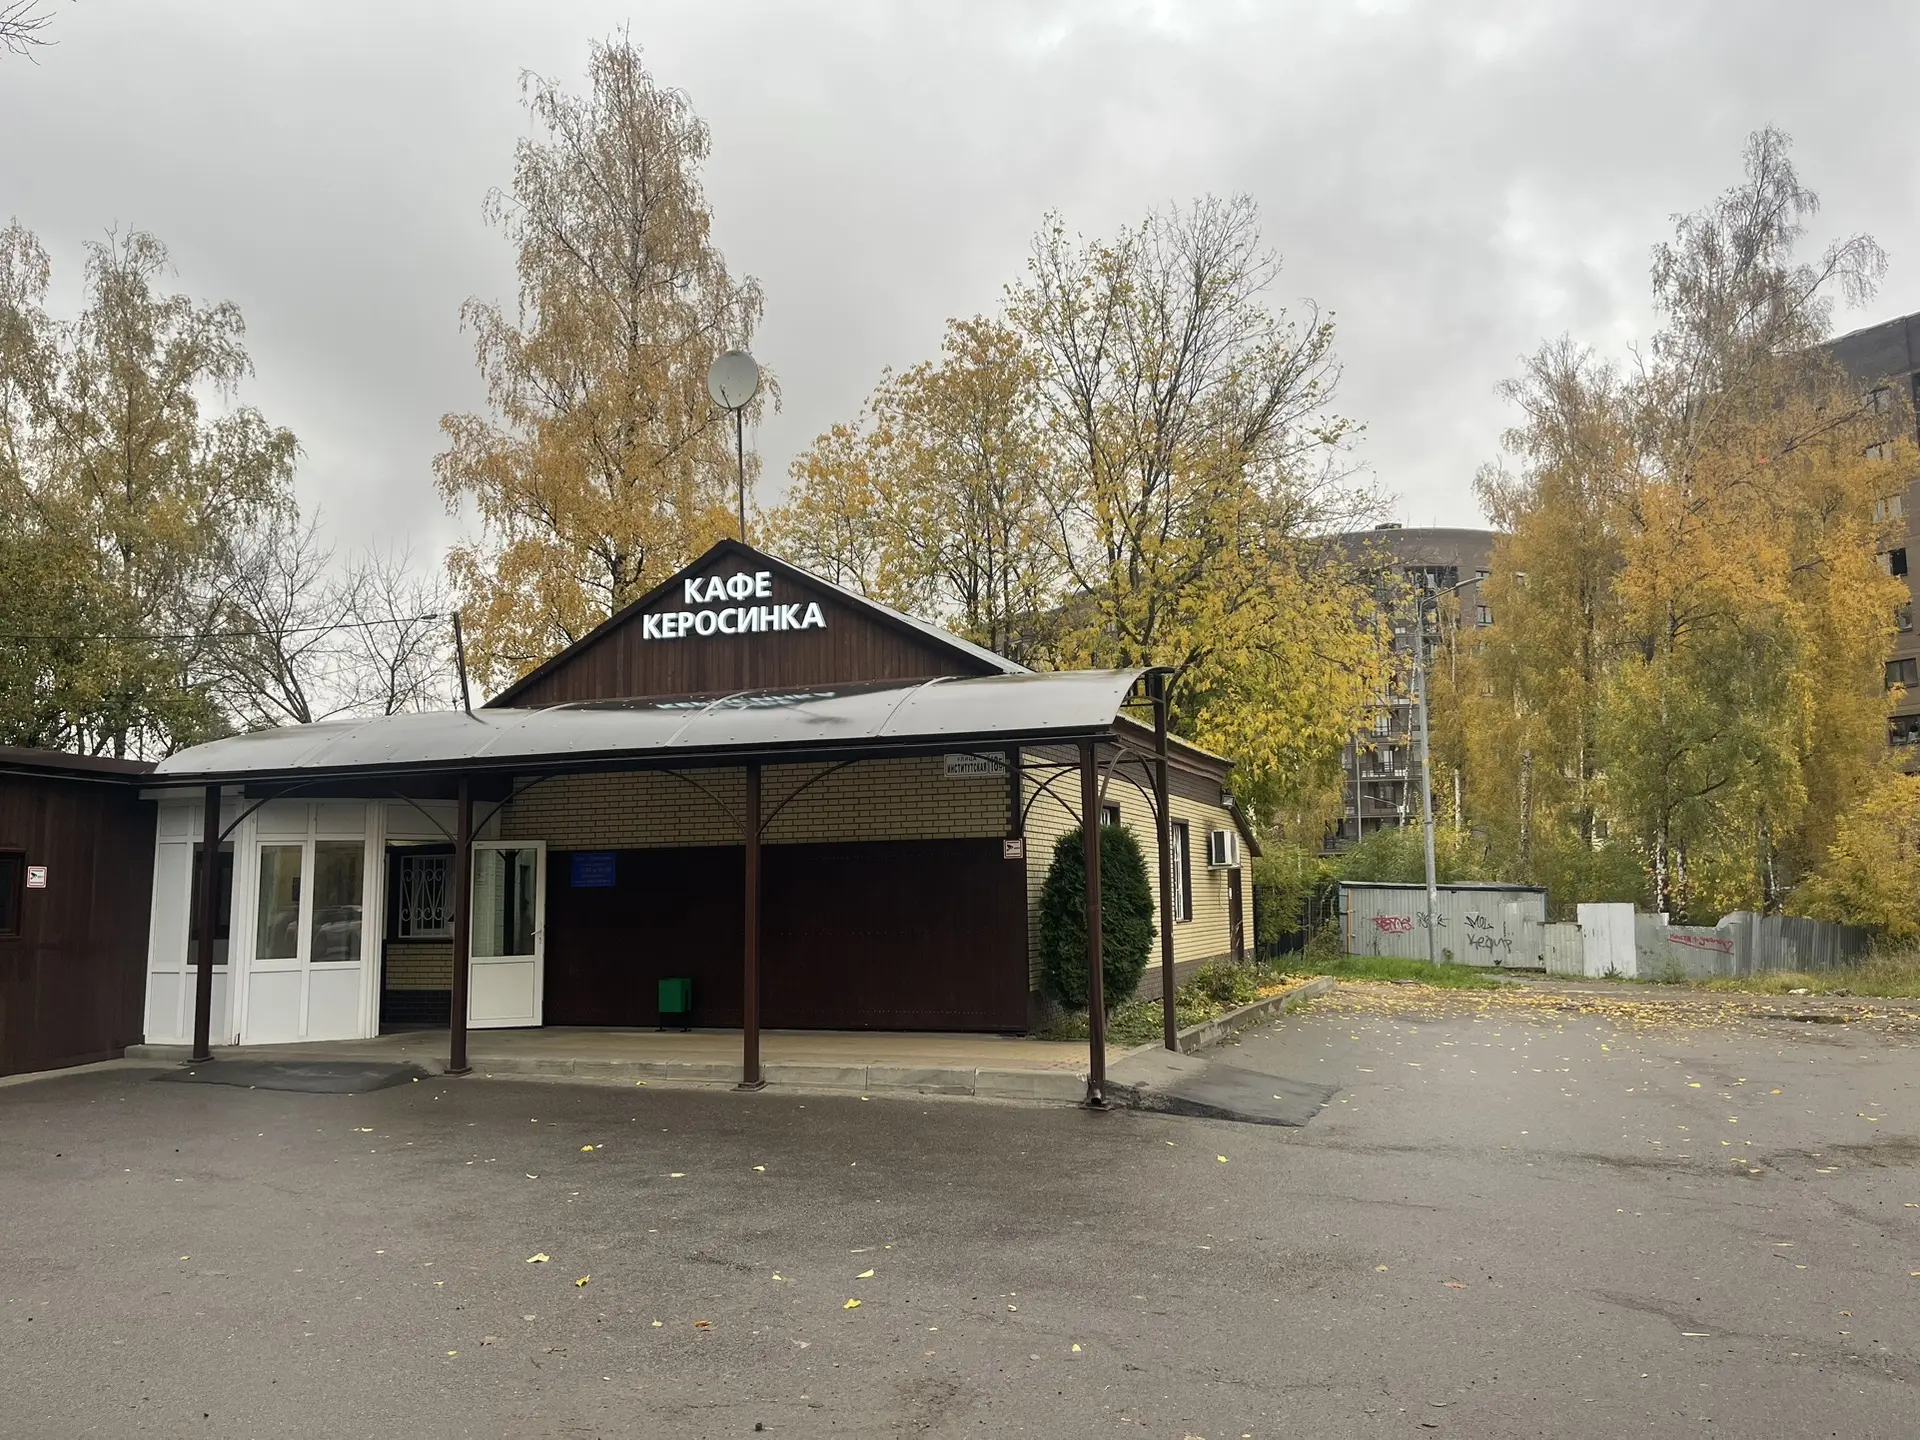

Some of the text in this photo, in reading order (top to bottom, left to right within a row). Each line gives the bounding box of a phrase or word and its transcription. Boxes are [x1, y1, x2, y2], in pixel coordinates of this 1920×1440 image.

[684, 571, 772, 603] КАФЕ
[642, 602, 827, 639] КЕРОСИНКА
[947, 762, 987, 774] ИНСТИТУТСКАЯ
